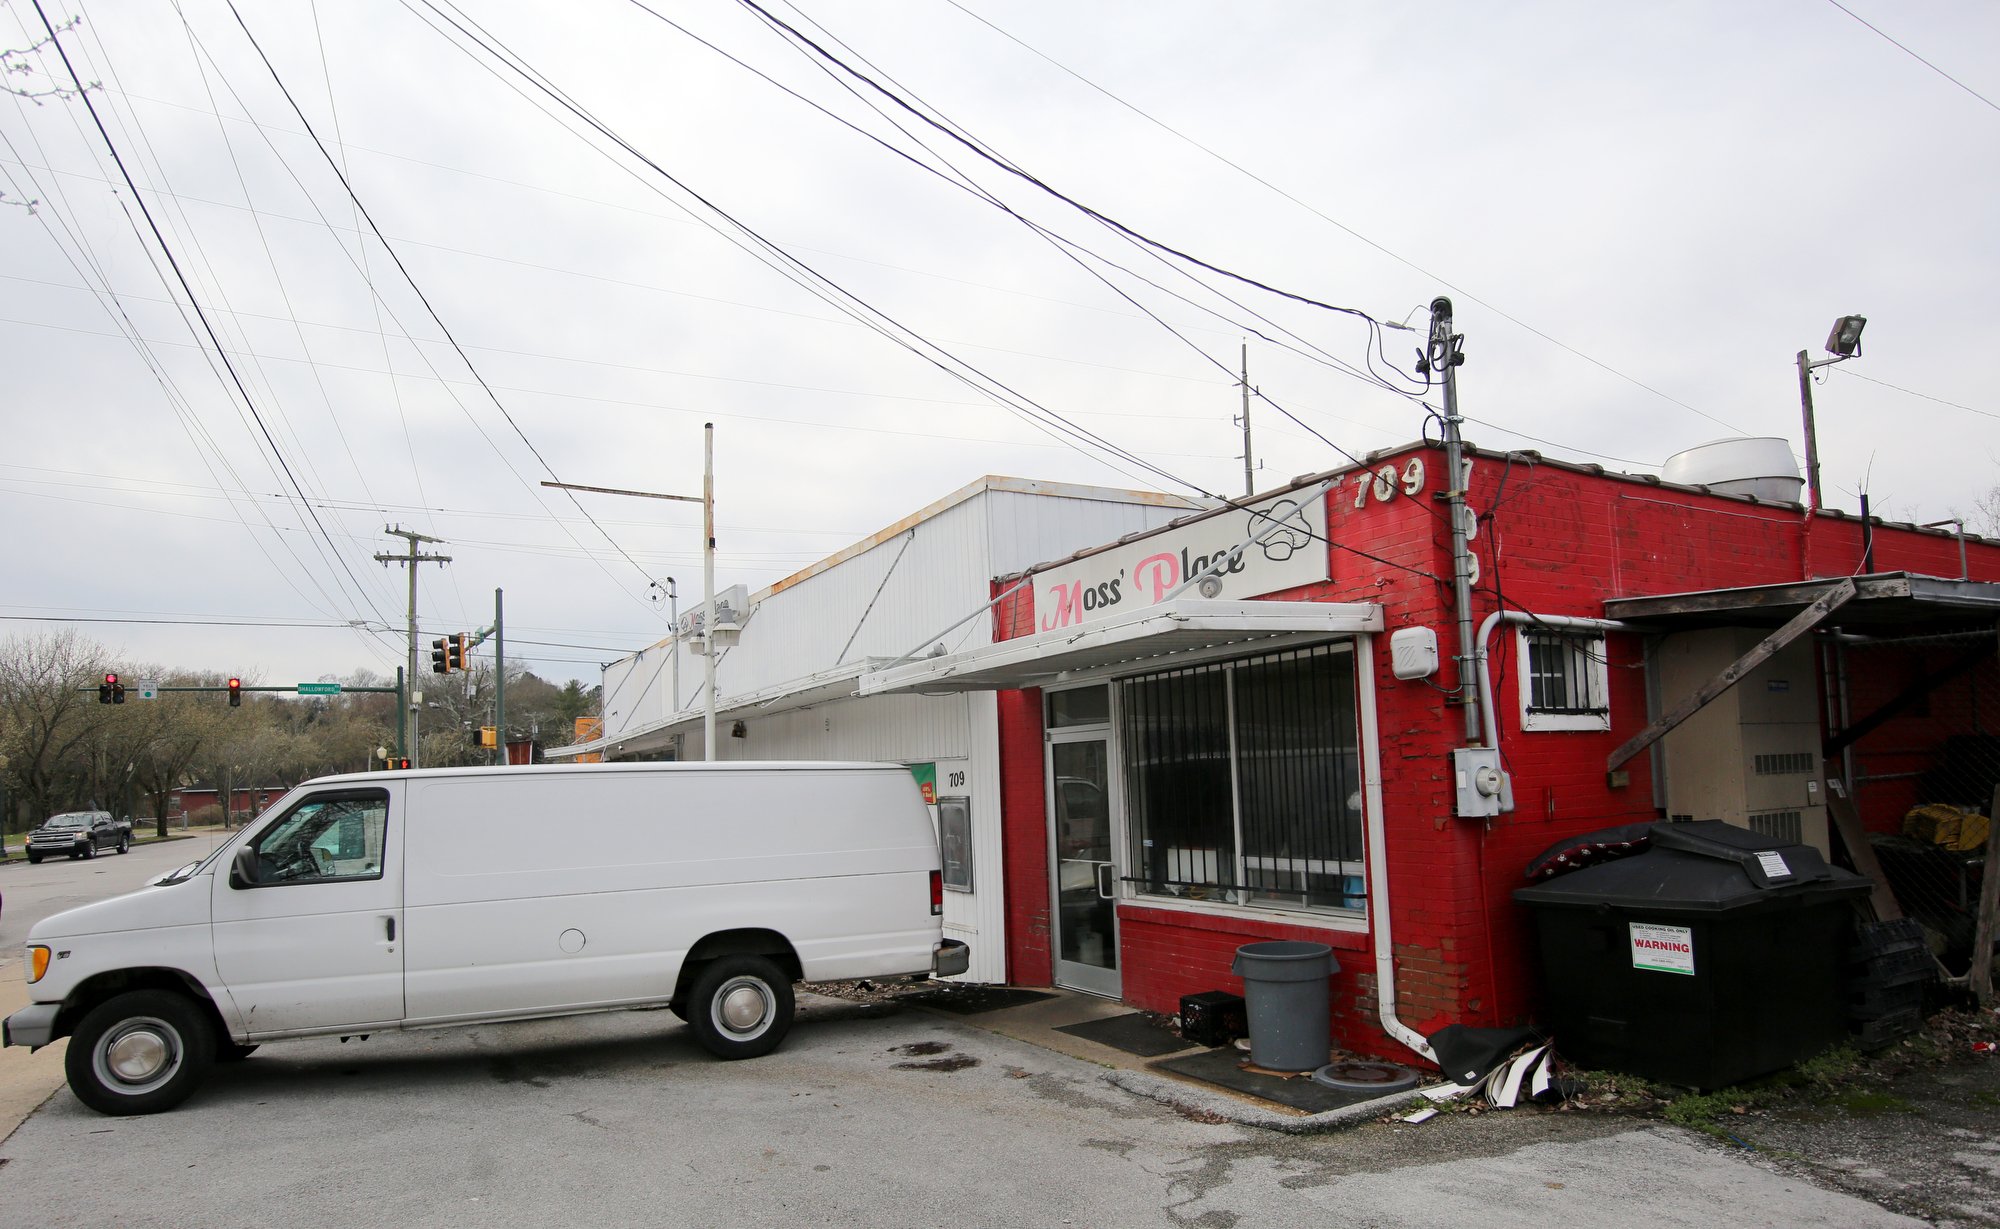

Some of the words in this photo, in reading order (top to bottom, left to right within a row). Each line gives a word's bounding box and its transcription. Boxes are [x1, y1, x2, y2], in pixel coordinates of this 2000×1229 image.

[1353, 457, 1425, 508] 709
[1041, 568, 1124, 632] Moss'
[1133, 544, 1246, 605] Place
[949, 770, 965, 787] 709
[1634, 938, 1690, 953] WARNING
